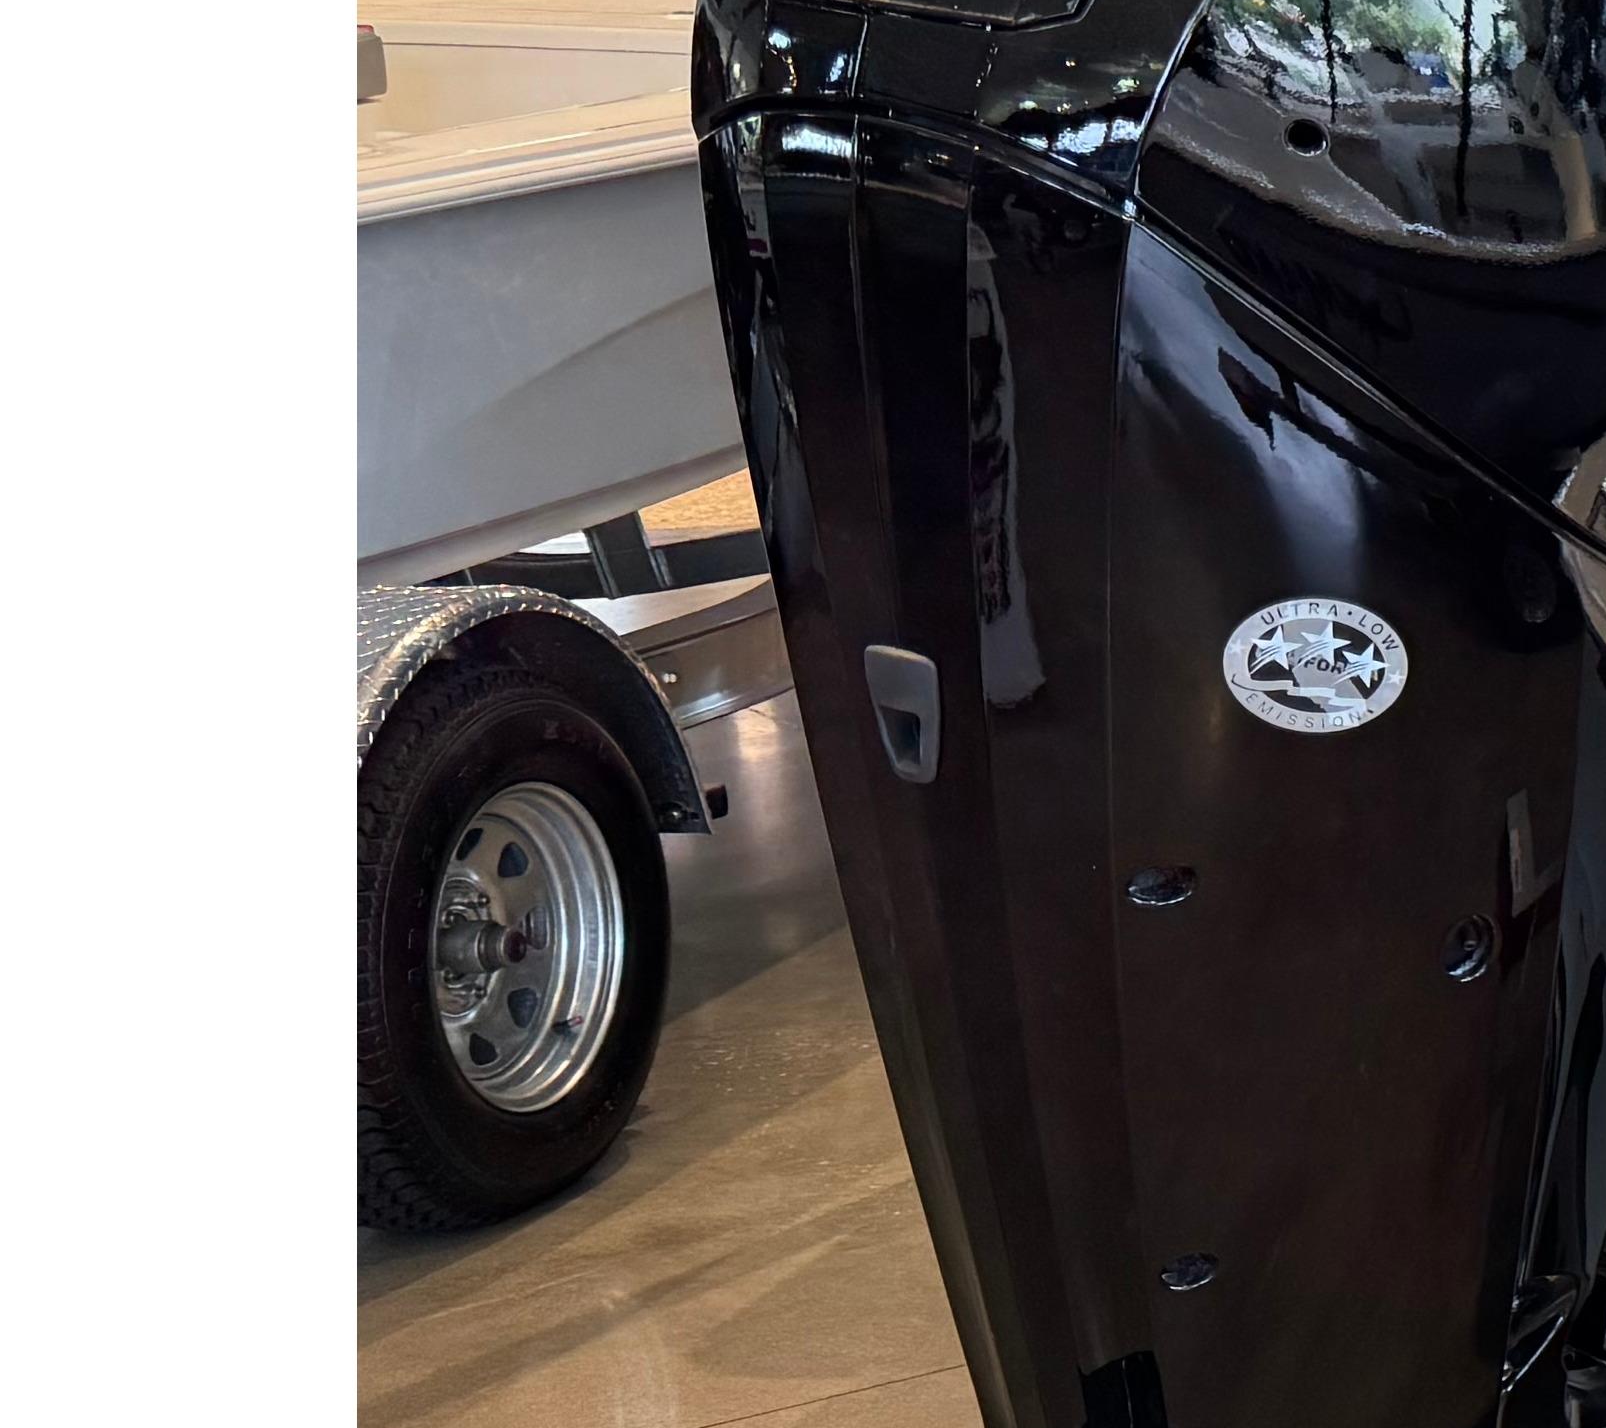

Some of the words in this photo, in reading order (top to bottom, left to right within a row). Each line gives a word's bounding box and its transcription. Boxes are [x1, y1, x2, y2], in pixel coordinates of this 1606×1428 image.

[1260, 601, 1339, 626] ULTRA
[1357, 613, 1400, 652] LOW
[1243, 692, 1364, 729] EMISSION
